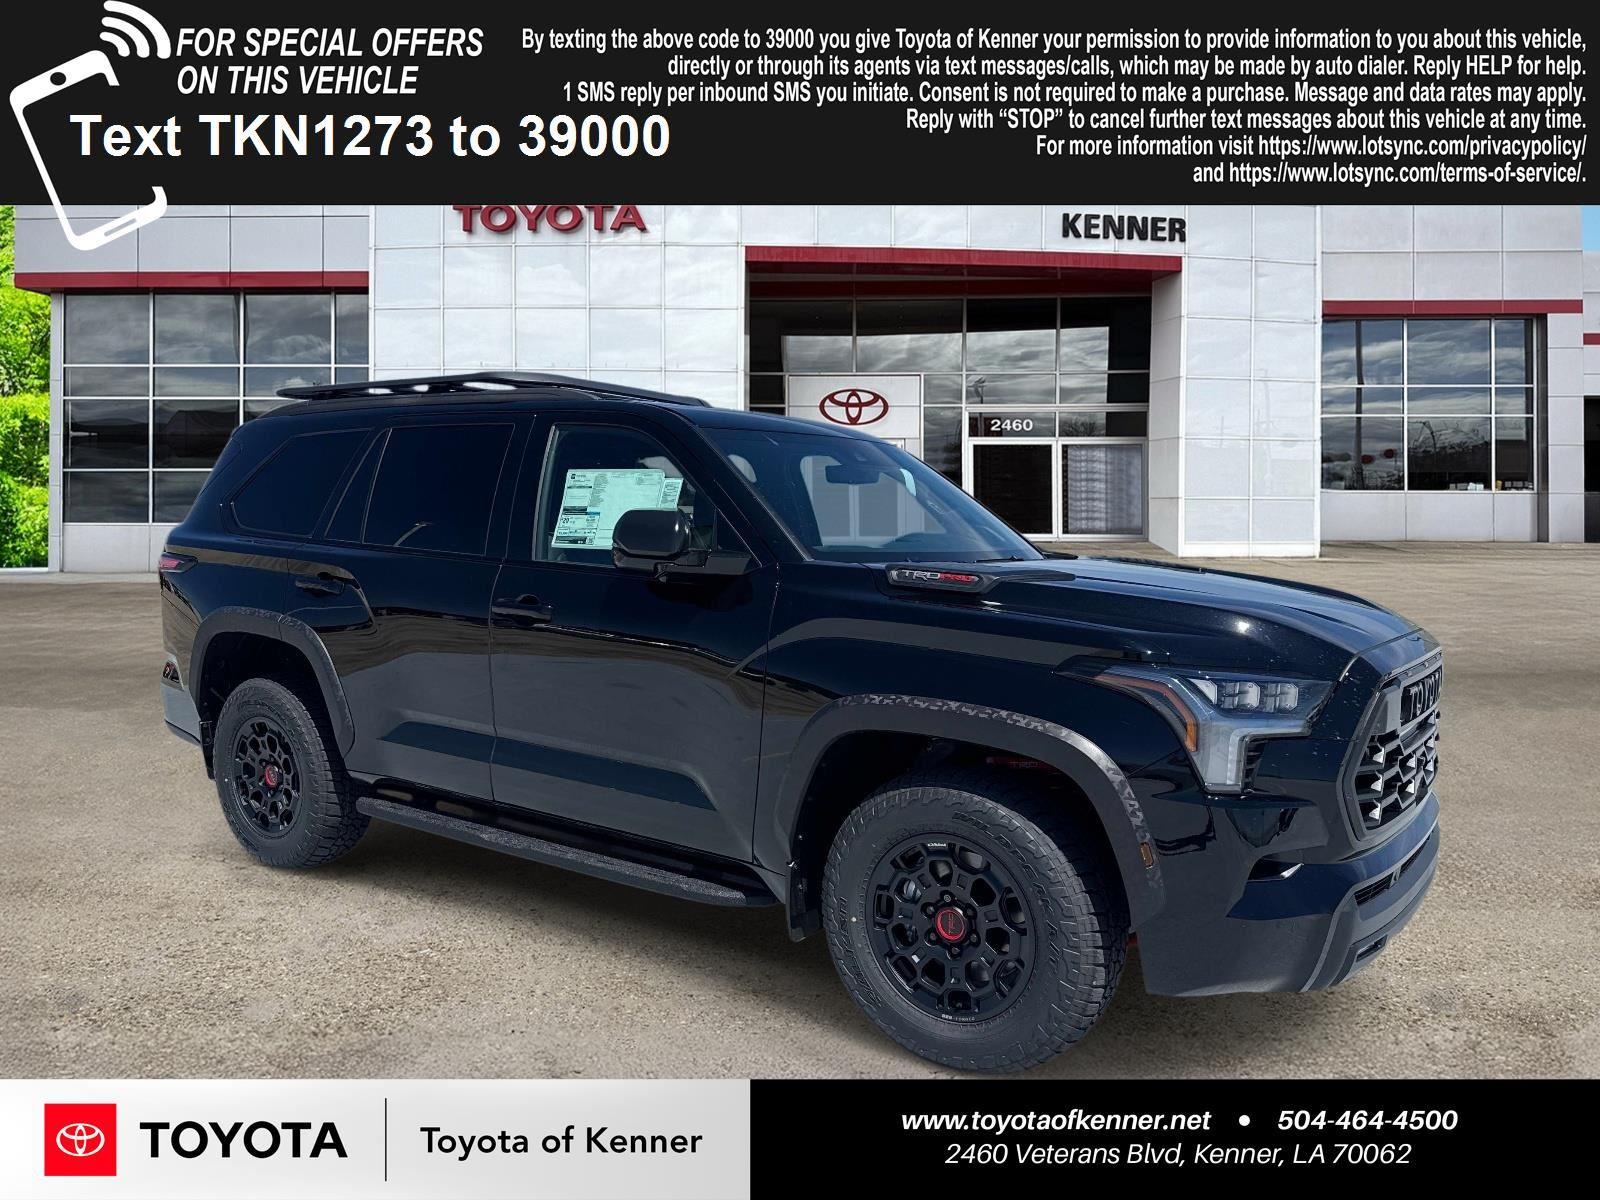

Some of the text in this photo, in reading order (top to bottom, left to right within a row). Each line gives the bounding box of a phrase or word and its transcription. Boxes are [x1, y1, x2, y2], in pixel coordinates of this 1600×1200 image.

[453, 205, 646, 233] TOYOTA
[1061, 212, 1187, 243] KENNER
[990, 418, 1033, 432] 2460
